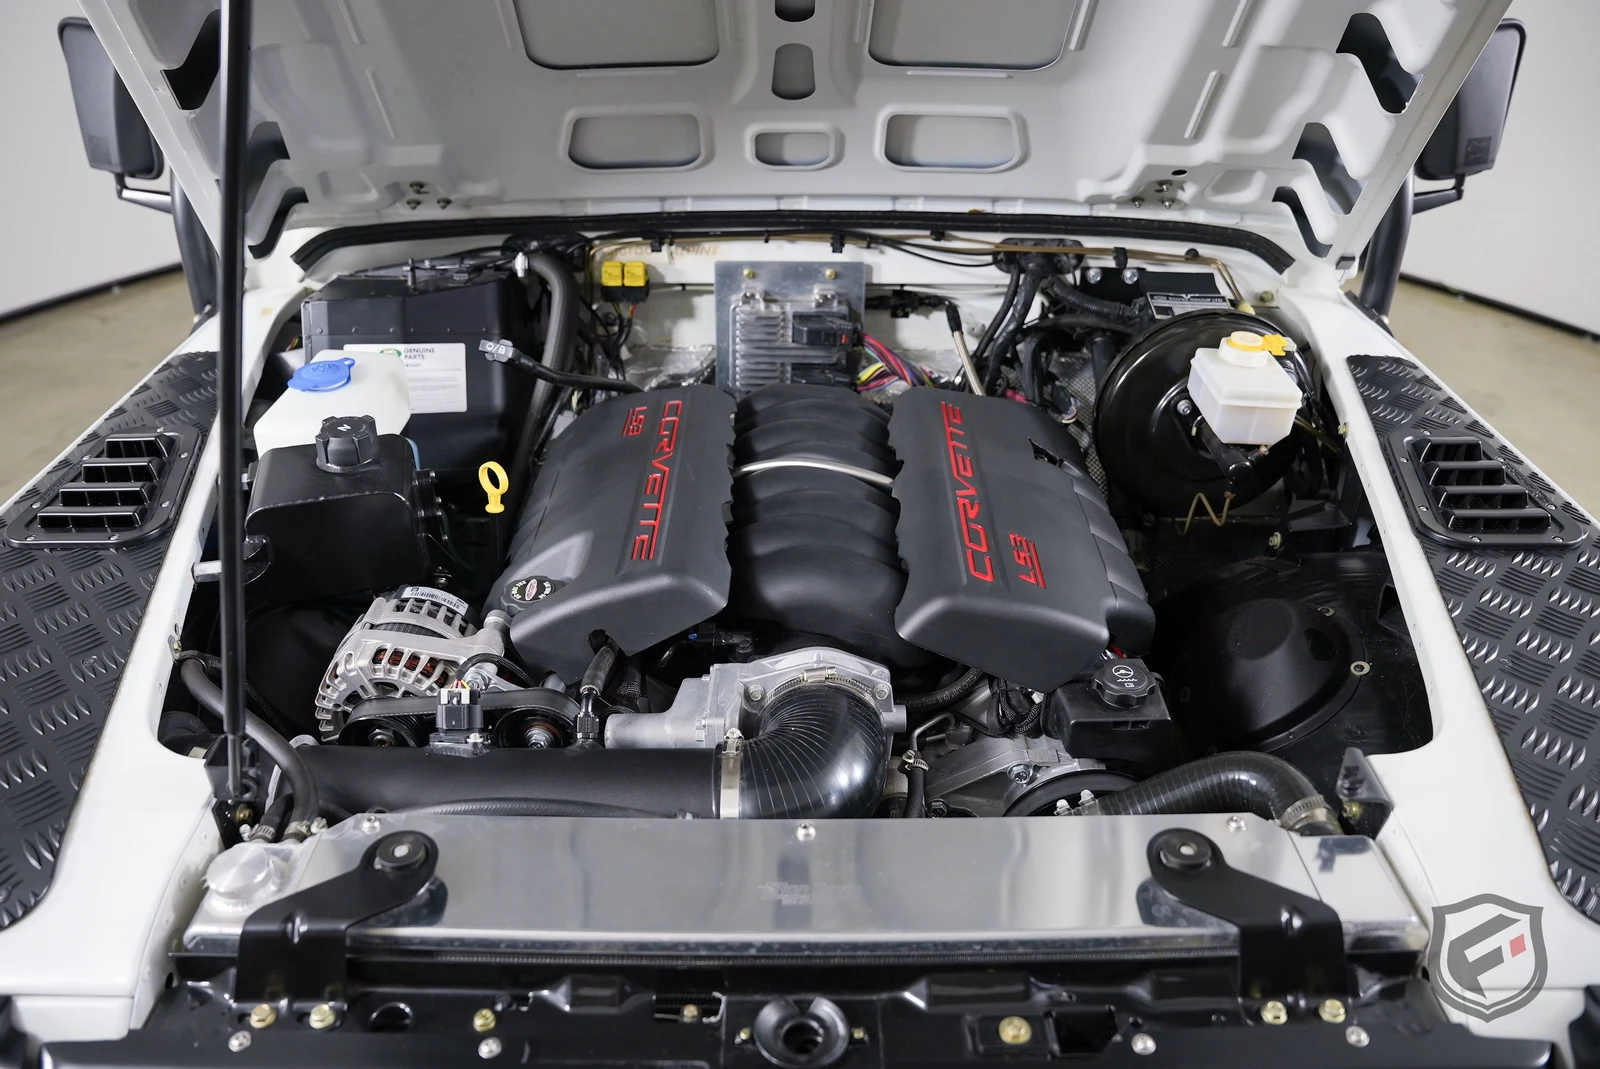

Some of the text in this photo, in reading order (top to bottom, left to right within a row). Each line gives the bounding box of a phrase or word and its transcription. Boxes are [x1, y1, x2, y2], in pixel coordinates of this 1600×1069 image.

[625, 406, 648, 437] LS3
[631, 400, 683, 561] CORVETTE
[940, 401, 996, 583] CORVETTE
[1008, 530, 1041, 587] LS3
